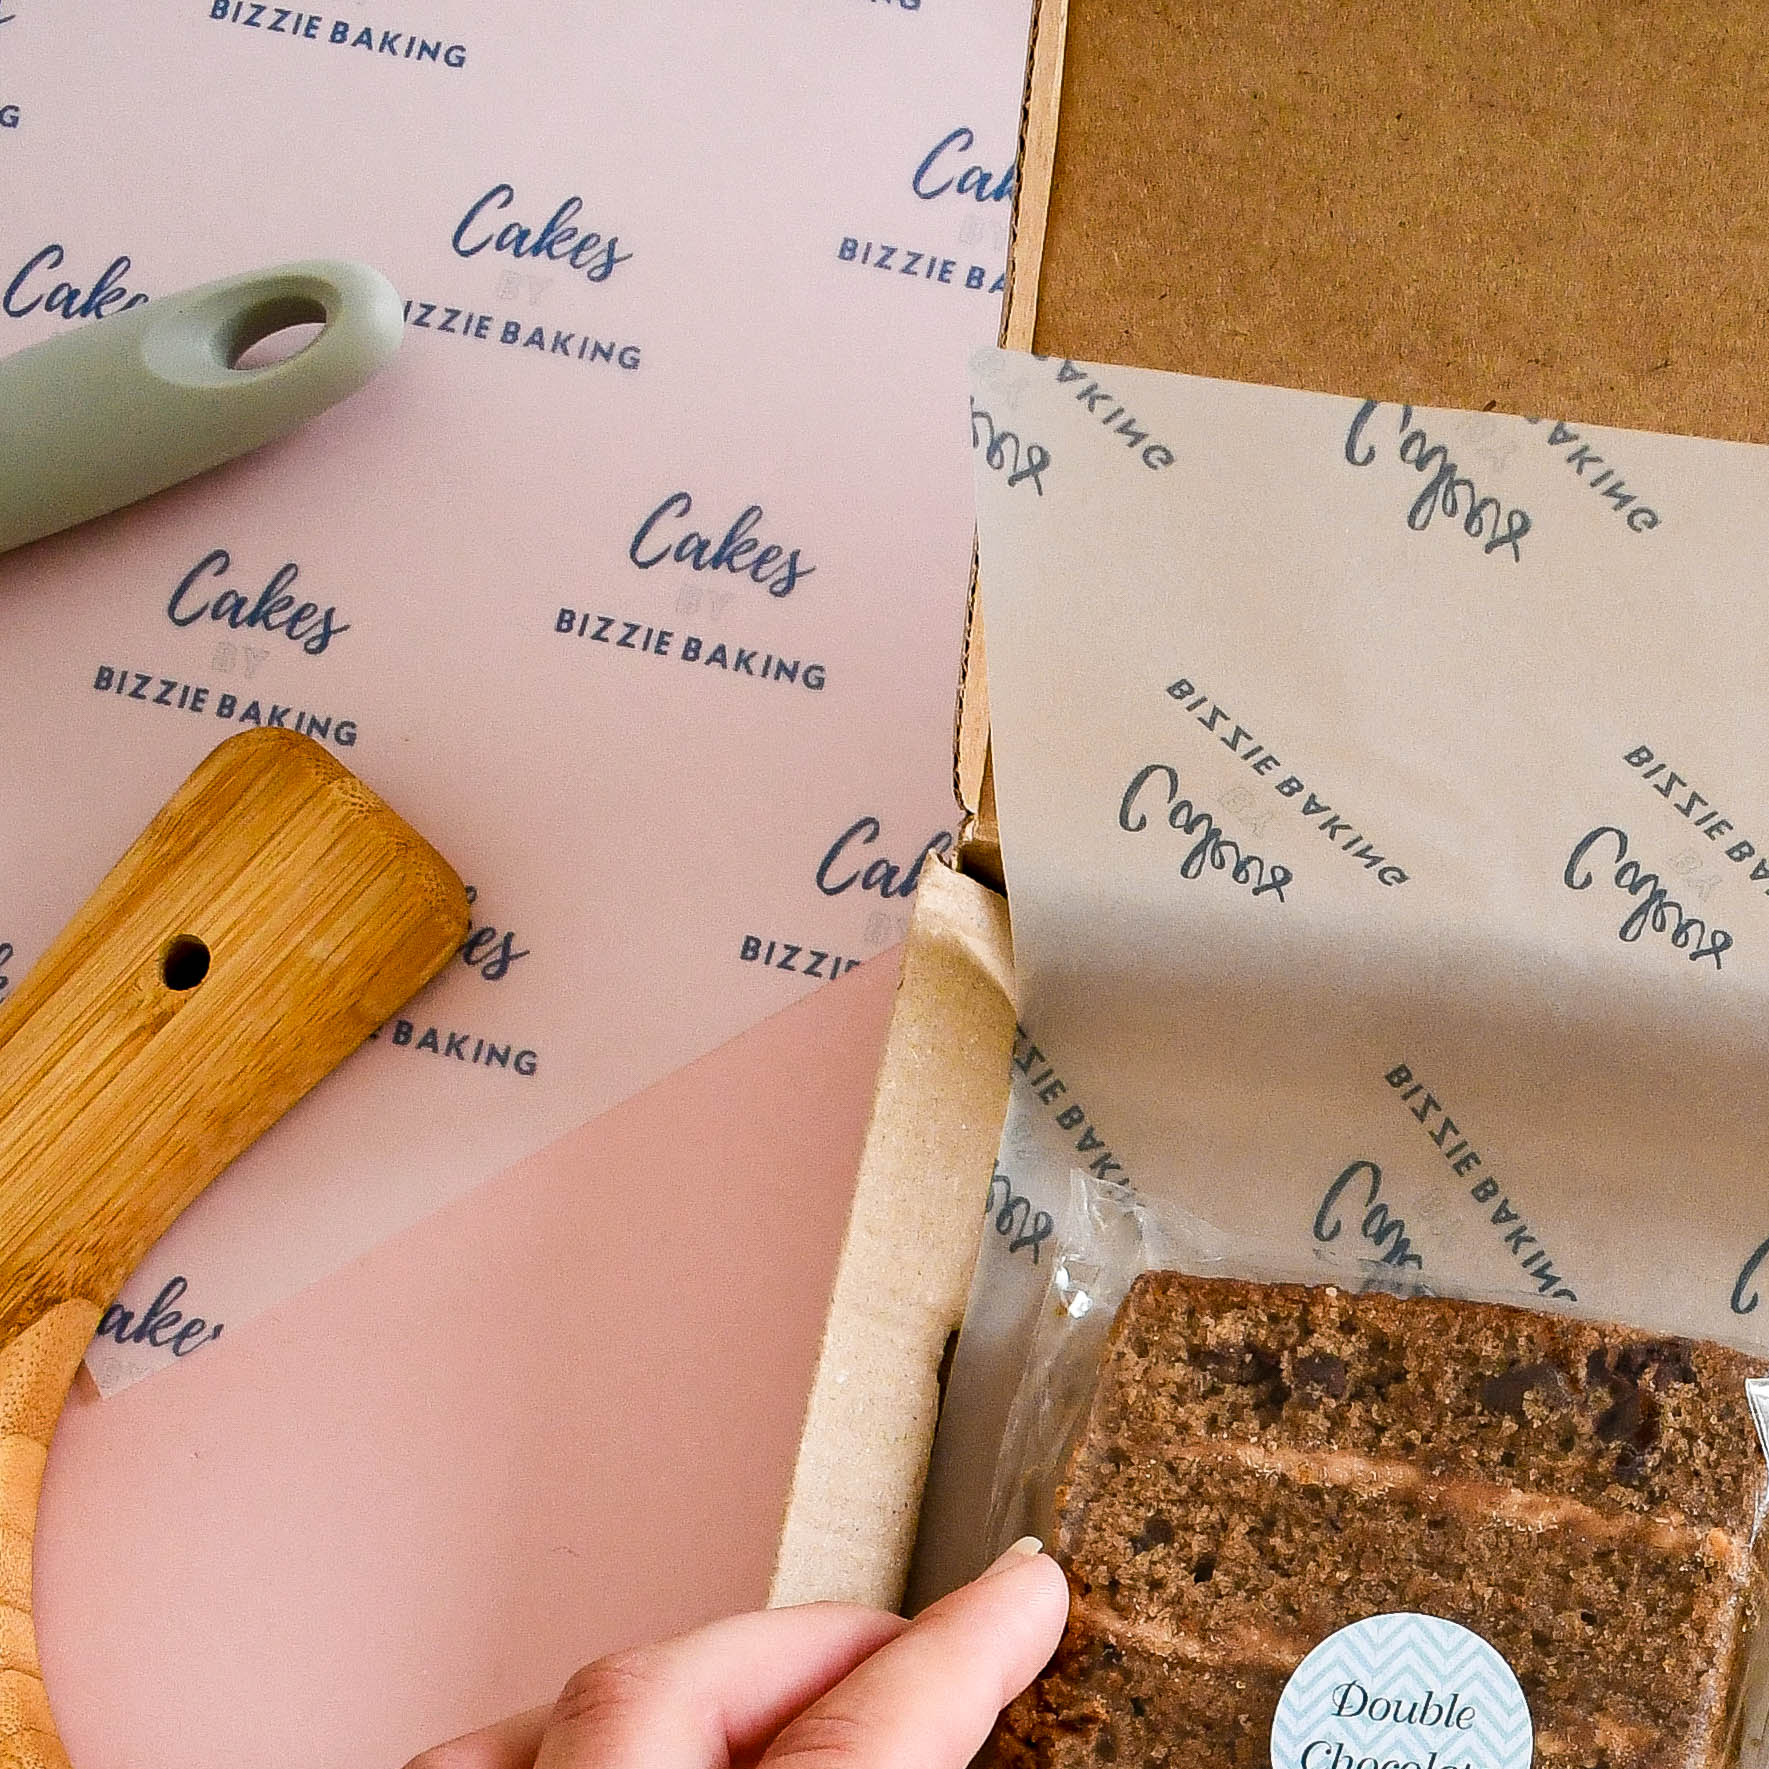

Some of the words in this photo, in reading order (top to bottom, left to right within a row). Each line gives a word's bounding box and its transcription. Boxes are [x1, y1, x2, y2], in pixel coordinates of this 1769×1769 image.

[209, 0, 322, 40] BIZZIE
[329, 21, 468, 68] BAKING
[451, 184, 633, 283] Cakes
[838, 236, 956, 285] BIZZIE
[3, 244, 148, 319] Cak
[403, 301, 492, 340] IZZIE
[500, 320, 641, 370] BAKING
[630, 491, 816, 598] Cakes
[167, 549, 349, 655] Cakes
[555, 607, 672, 657] BIZZIE
[681, 636, 827, 691] BAKING
[93, 665, 210, 714] BIZZIE
[215, 692, 358, 747] BAKING
[815, 816, 953, 898] Cak
[392, 1019, 539, 1077] BAKING
[97, 1275, 225, 1357] ake
[1331, 1679, 1476, 1730] Double
